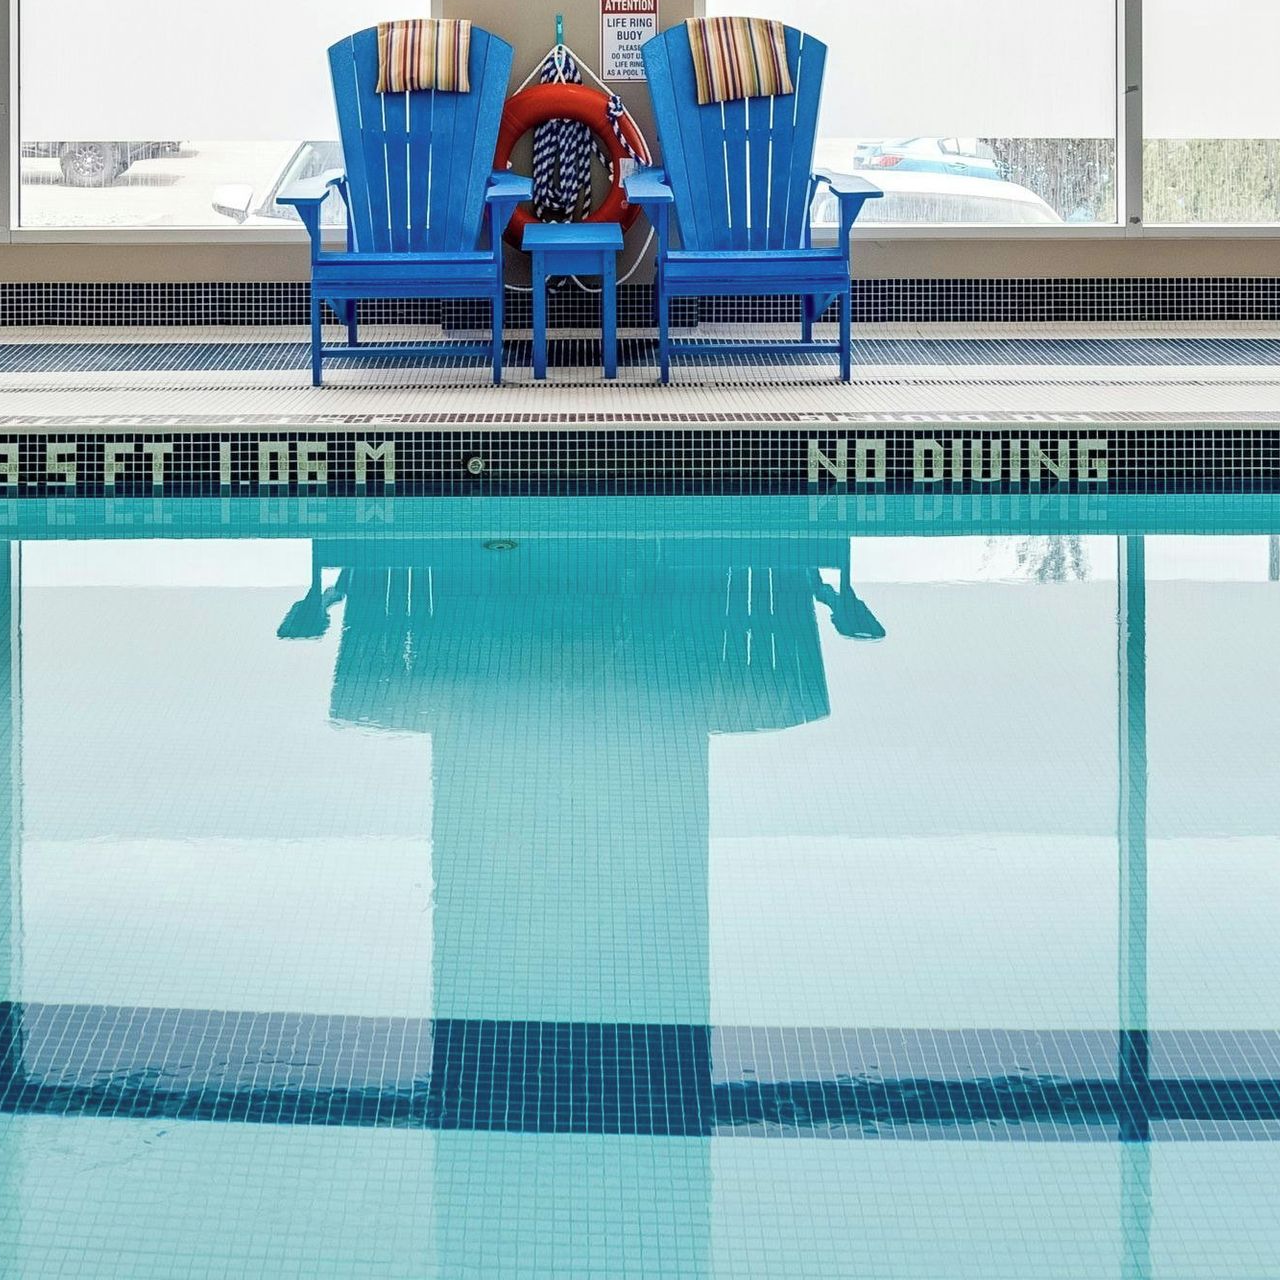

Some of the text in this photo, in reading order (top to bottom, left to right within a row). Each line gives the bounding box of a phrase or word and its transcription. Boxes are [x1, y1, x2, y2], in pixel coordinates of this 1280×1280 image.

[605, 0, 654, 11] ATTENTION
[607, 18, 652, 27] LIFE RING
[617, 30, 643, 40] BUOY
[611, 52, 621, 60] DO
[622, 52, 634, 60] NOT
[615, 60, 628, 68] LIFE
[104, 442, 174, 486] FT
[220, 441, 328, 486] 1.06
[355, 441, 395, 485] M
[807, 439, 1109, 483] NO DIVING
